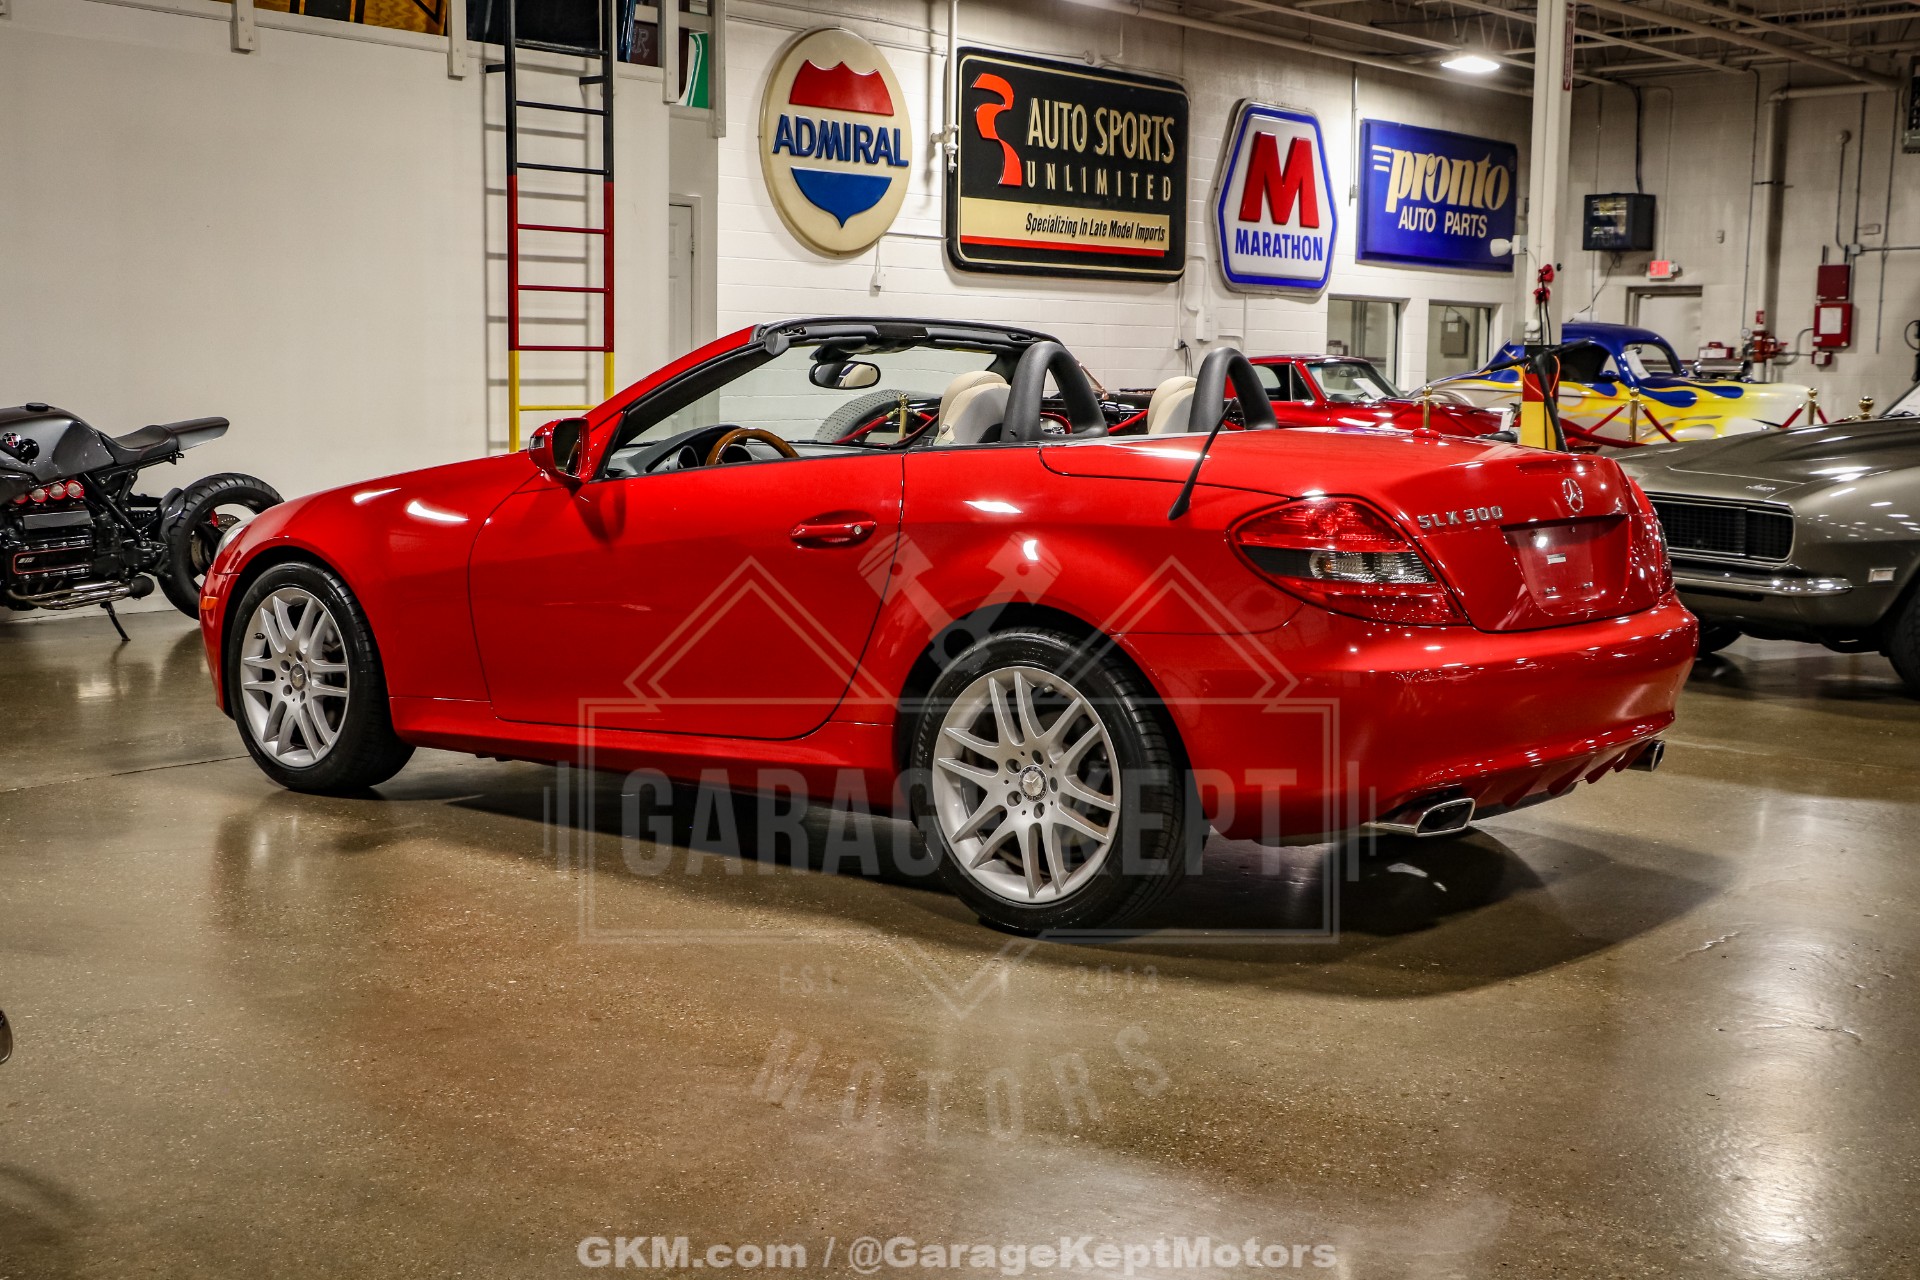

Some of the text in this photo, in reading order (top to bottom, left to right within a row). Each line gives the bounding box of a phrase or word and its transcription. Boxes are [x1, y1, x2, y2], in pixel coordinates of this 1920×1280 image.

[772, 113, 909, 168] ADMIRAL
[1026, 97, 1175, 164] AUTO SPORTS
[1025, 160, 1172, 202] UNLIMITED
[1238, 130, 1320, 229] M
[1384, 148, 1511, 213] pronto
[1025, 212, 1166, 244] Specializing In Late Model Imports
[1398, 204, 1489, 239] AUTO PARTS
[1235, 227, 1324, 262] MARATHON
[1417, 505, 1504, 529] SLK 300
